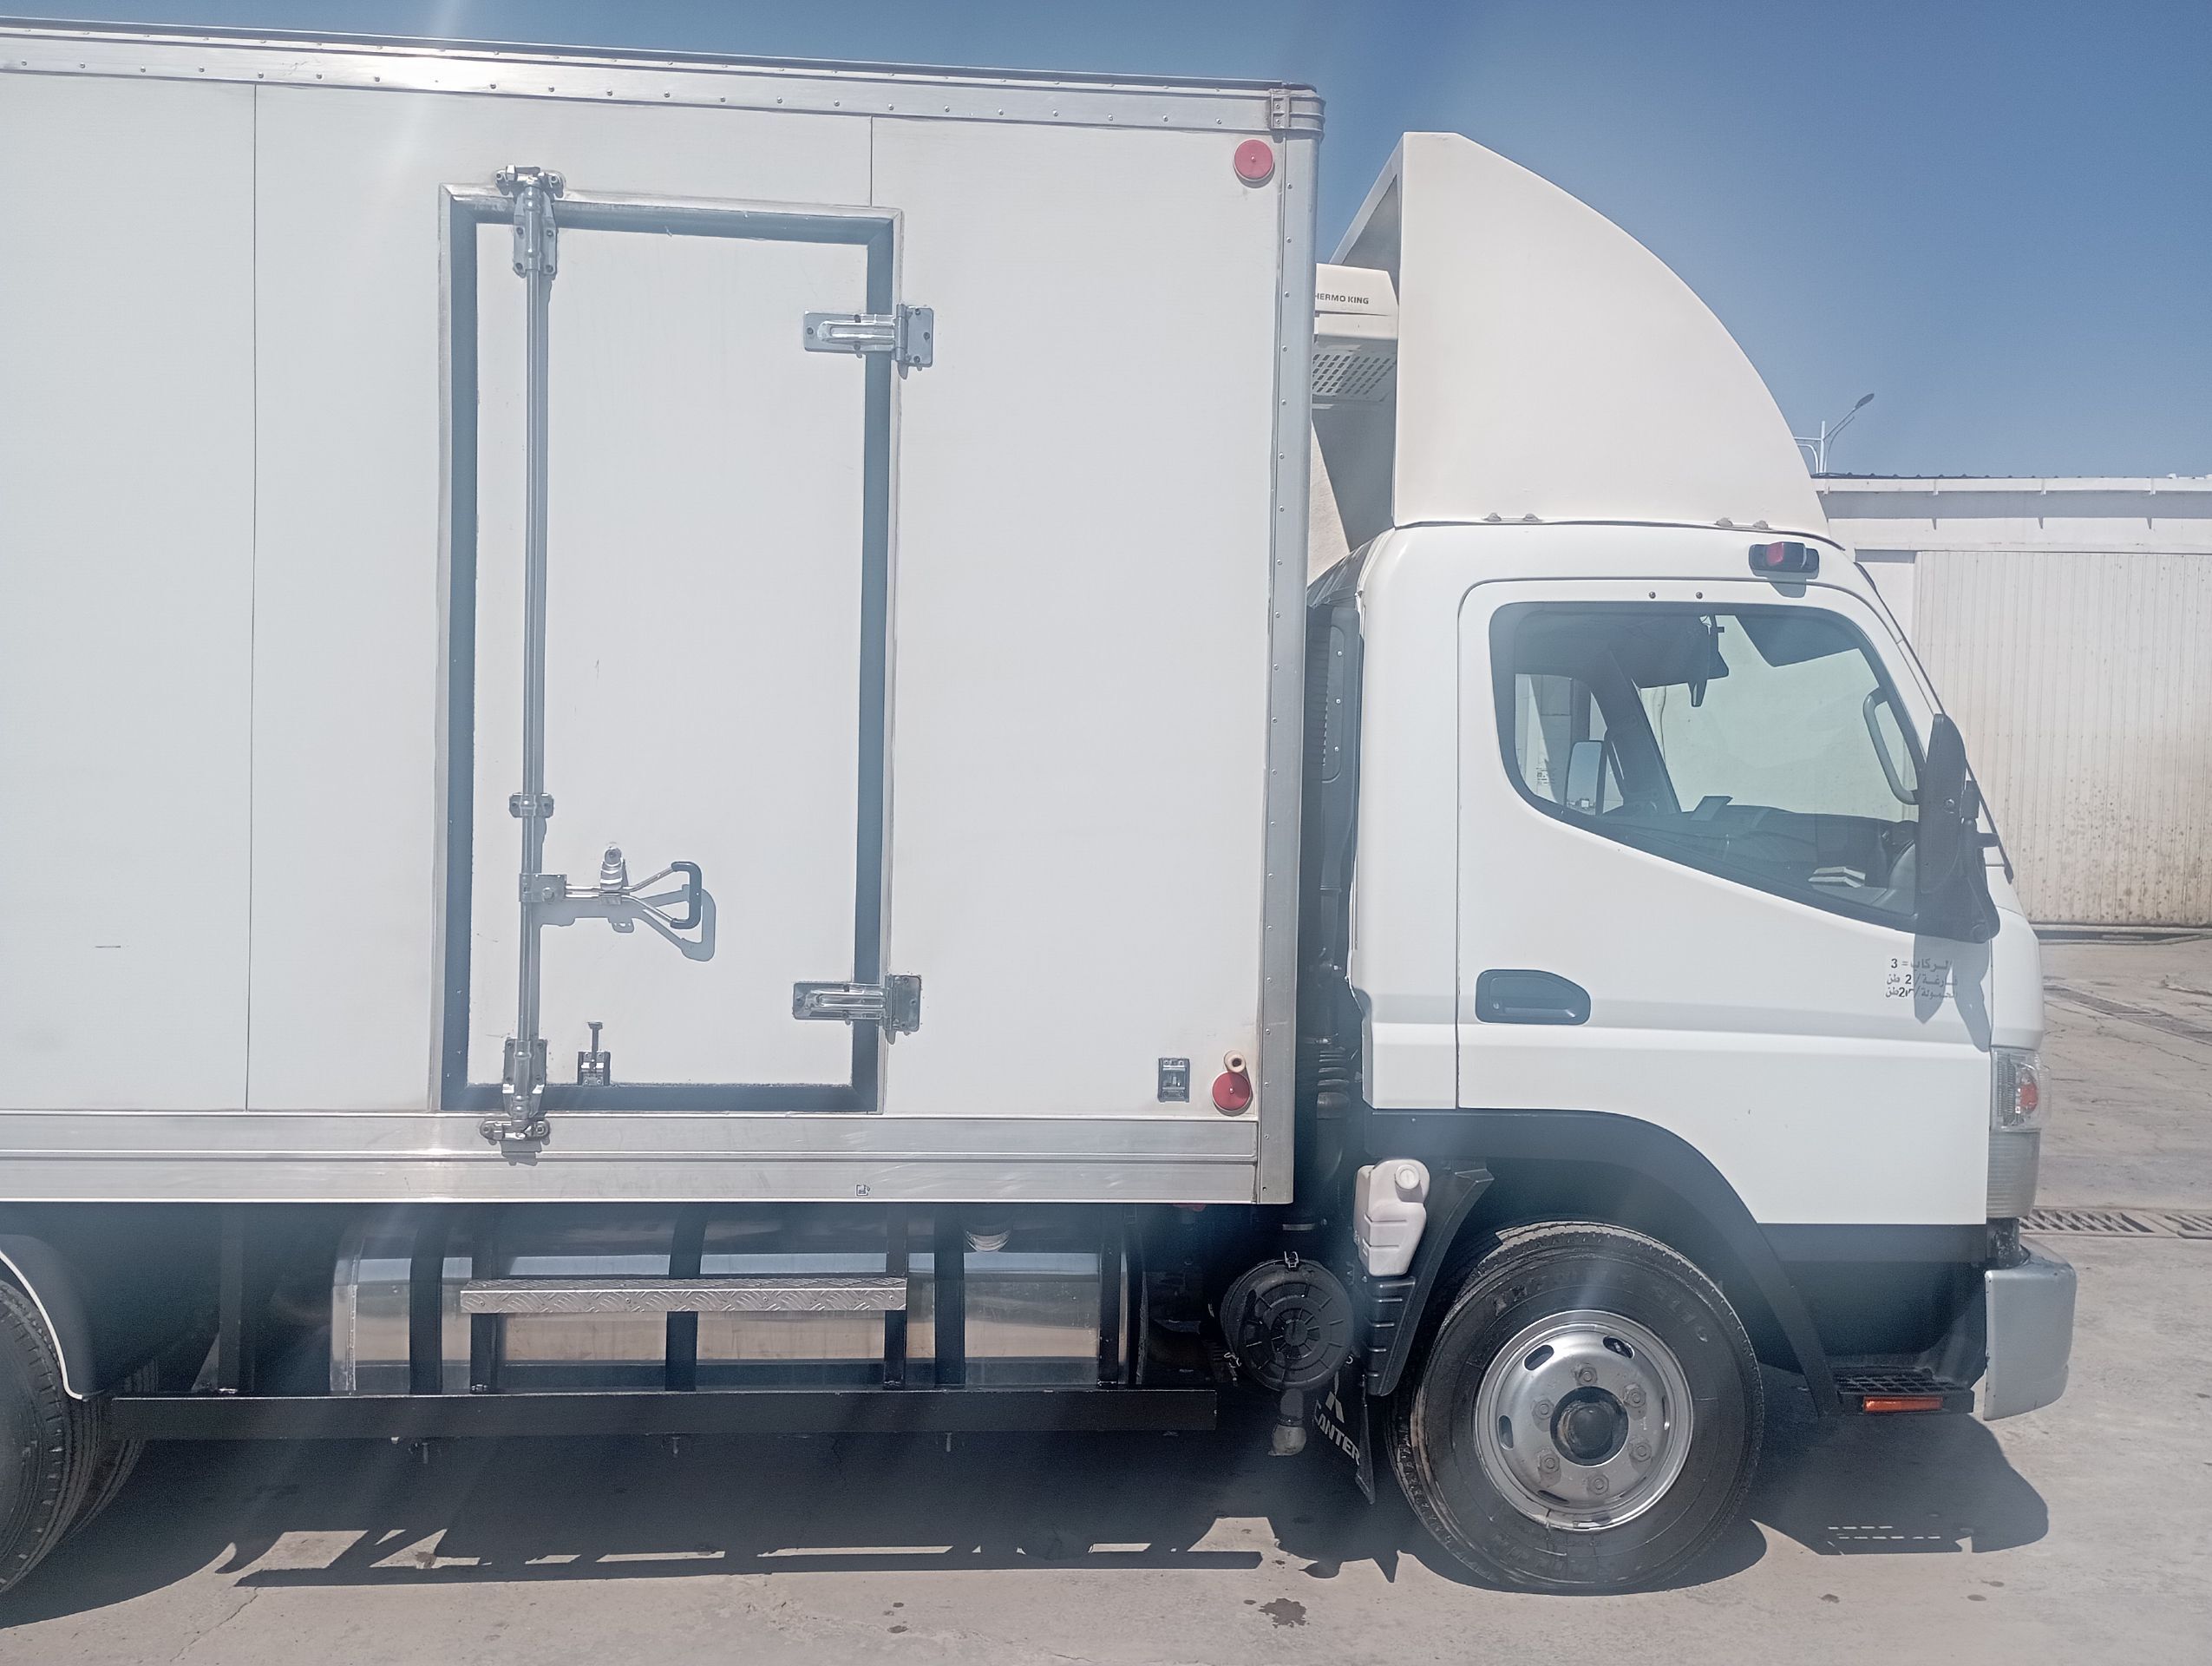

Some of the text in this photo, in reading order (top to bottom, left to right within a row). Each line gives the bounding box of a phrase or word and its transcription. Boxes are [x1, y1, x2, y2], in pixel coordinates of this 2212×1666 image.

[1315, 292, 1370, 305] HERMO KING
[1890, 958, 1898, 969] 3
[1904, 974, 1912, 985] 2
[1313, 1399, 1360, 1466] CANTER
